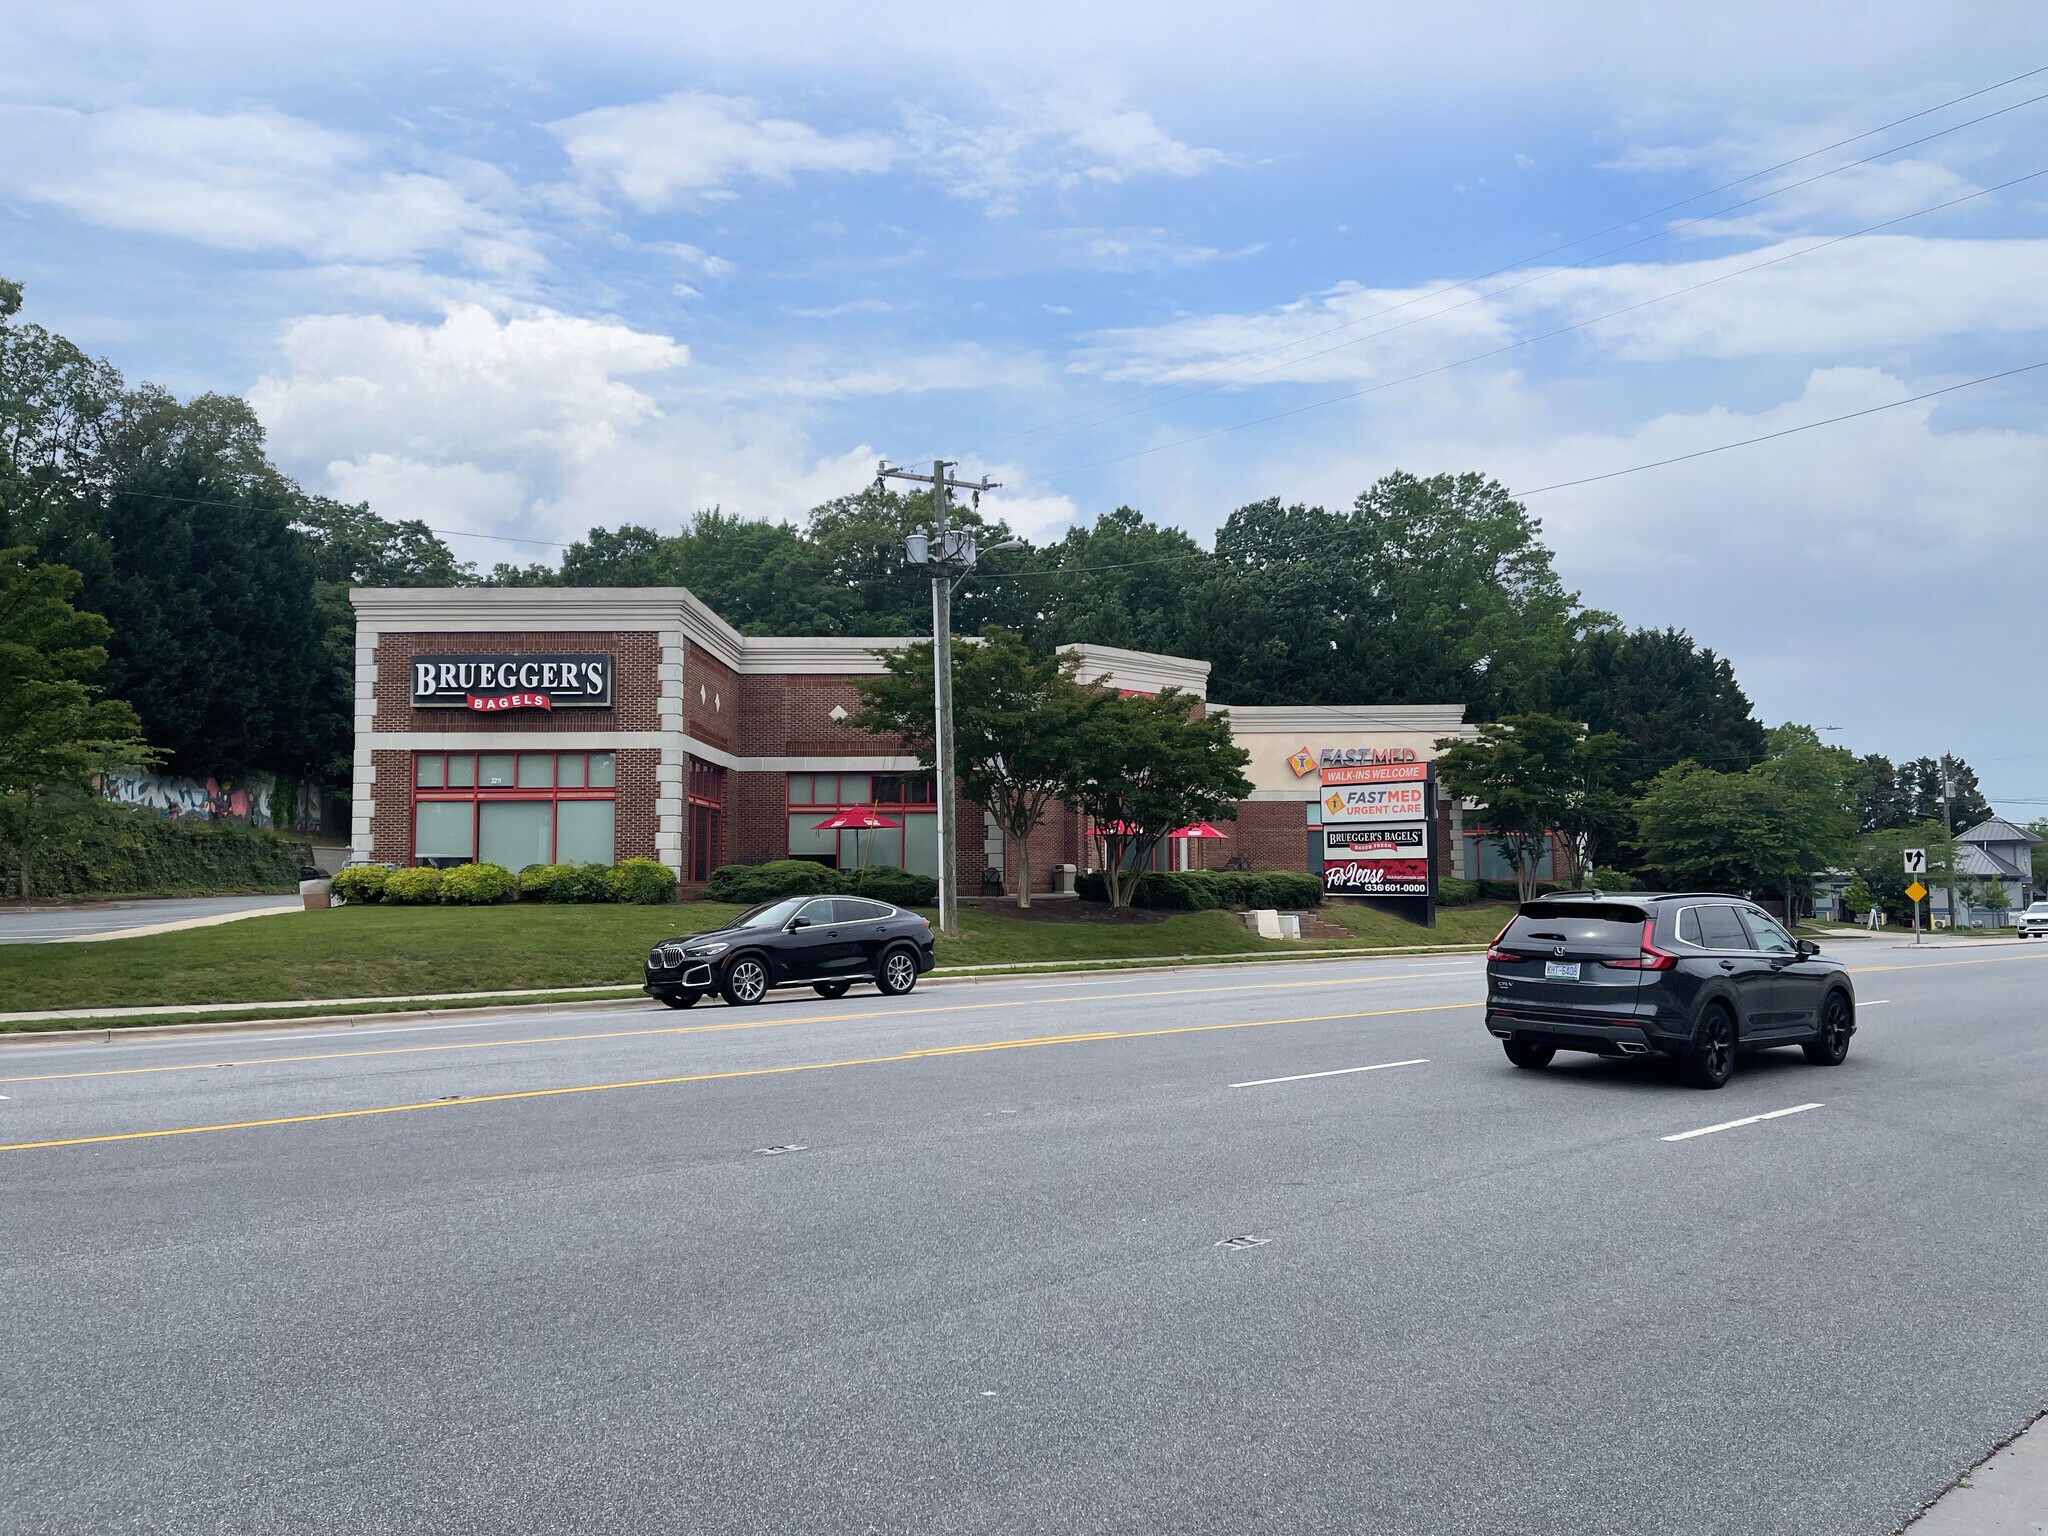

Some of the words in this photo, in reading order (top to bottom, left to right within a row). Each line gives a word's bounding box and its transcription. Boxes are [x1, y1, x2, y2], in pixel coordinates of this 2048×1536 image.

[414, 662, 603, 696] BRUEGGER'S
[473, 695, 543, 709] BAGELS
[1319, 748, 1417, 767] FASTMED
[1327, 769, 1371, 782] WALK-INS
[1372, 767, 1420, 779] WELCOME
[1346, 790, 1422, 804] FASTMED
[1346, 805, 1389, 816] URGENT
[1391, 804, 1422, 813] CARE
[1329, 831, 1383, 845] BRUEGGER'S
[1354, 843, 1373, 851] BAKED
[1325, 867, 1347, 889] For
[1345, 861, 1384, 886] Lease
[1364, 884, 1384, 892] (336)
[1384, 884, 1426, 892] 601-0000
